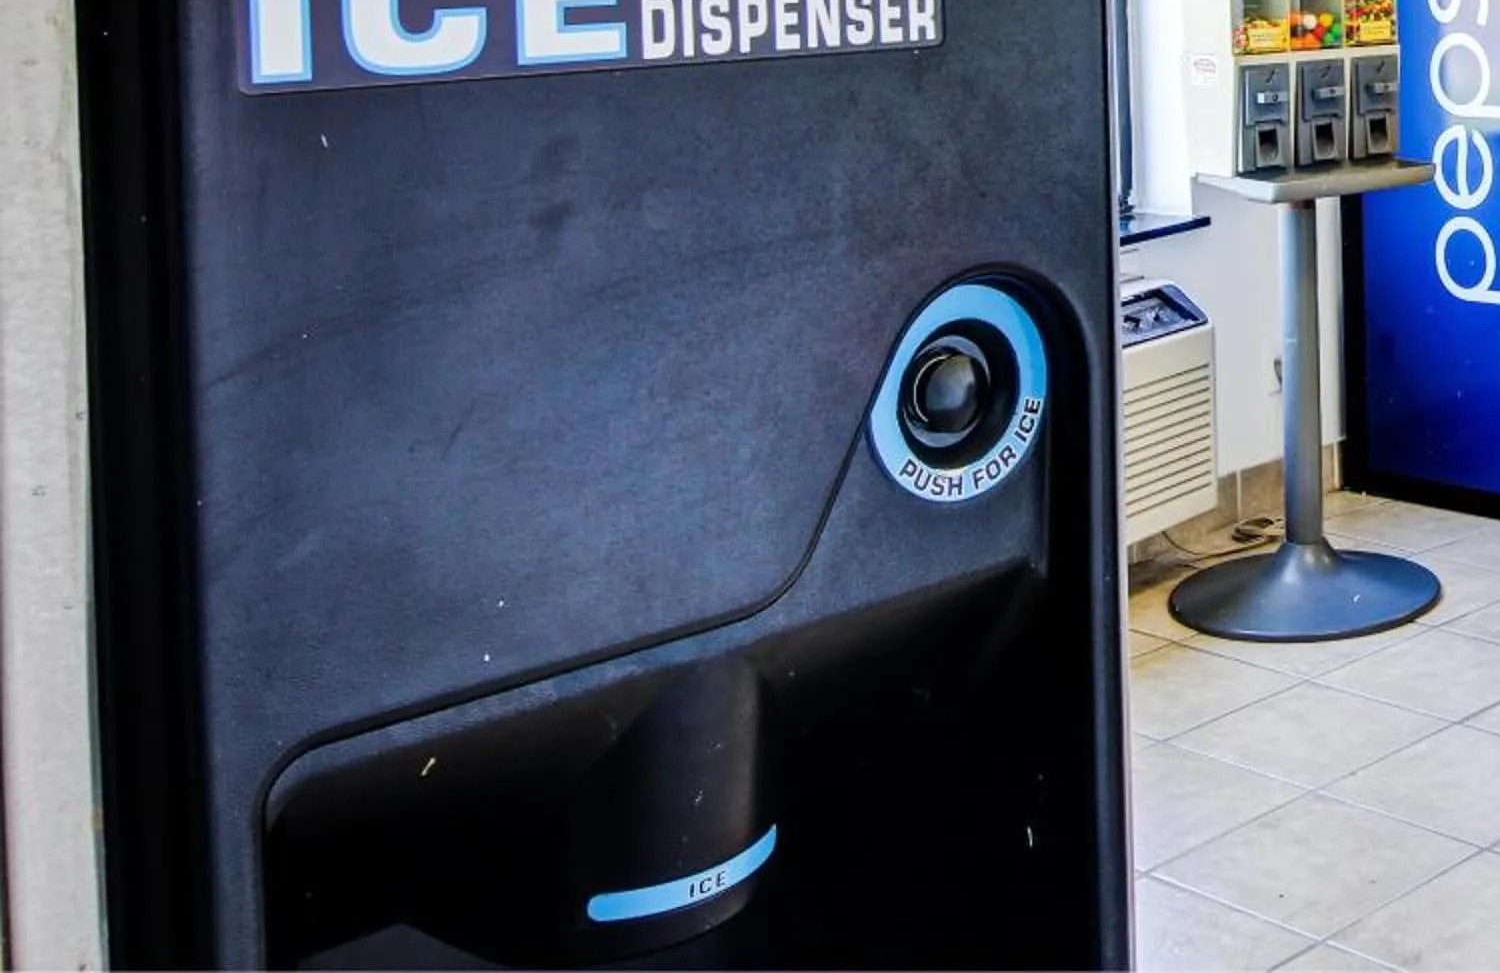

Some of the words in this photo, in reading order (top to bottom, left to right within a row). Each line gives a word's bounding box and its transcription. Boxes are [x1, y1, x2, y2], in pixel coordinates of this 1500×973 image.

[900, 459, 963, 495] PUSH
[972, 445, 1017, 489] FOR
[1014, 398, 1041, 444] ICE
[688, 870, 727, 898] ICE
